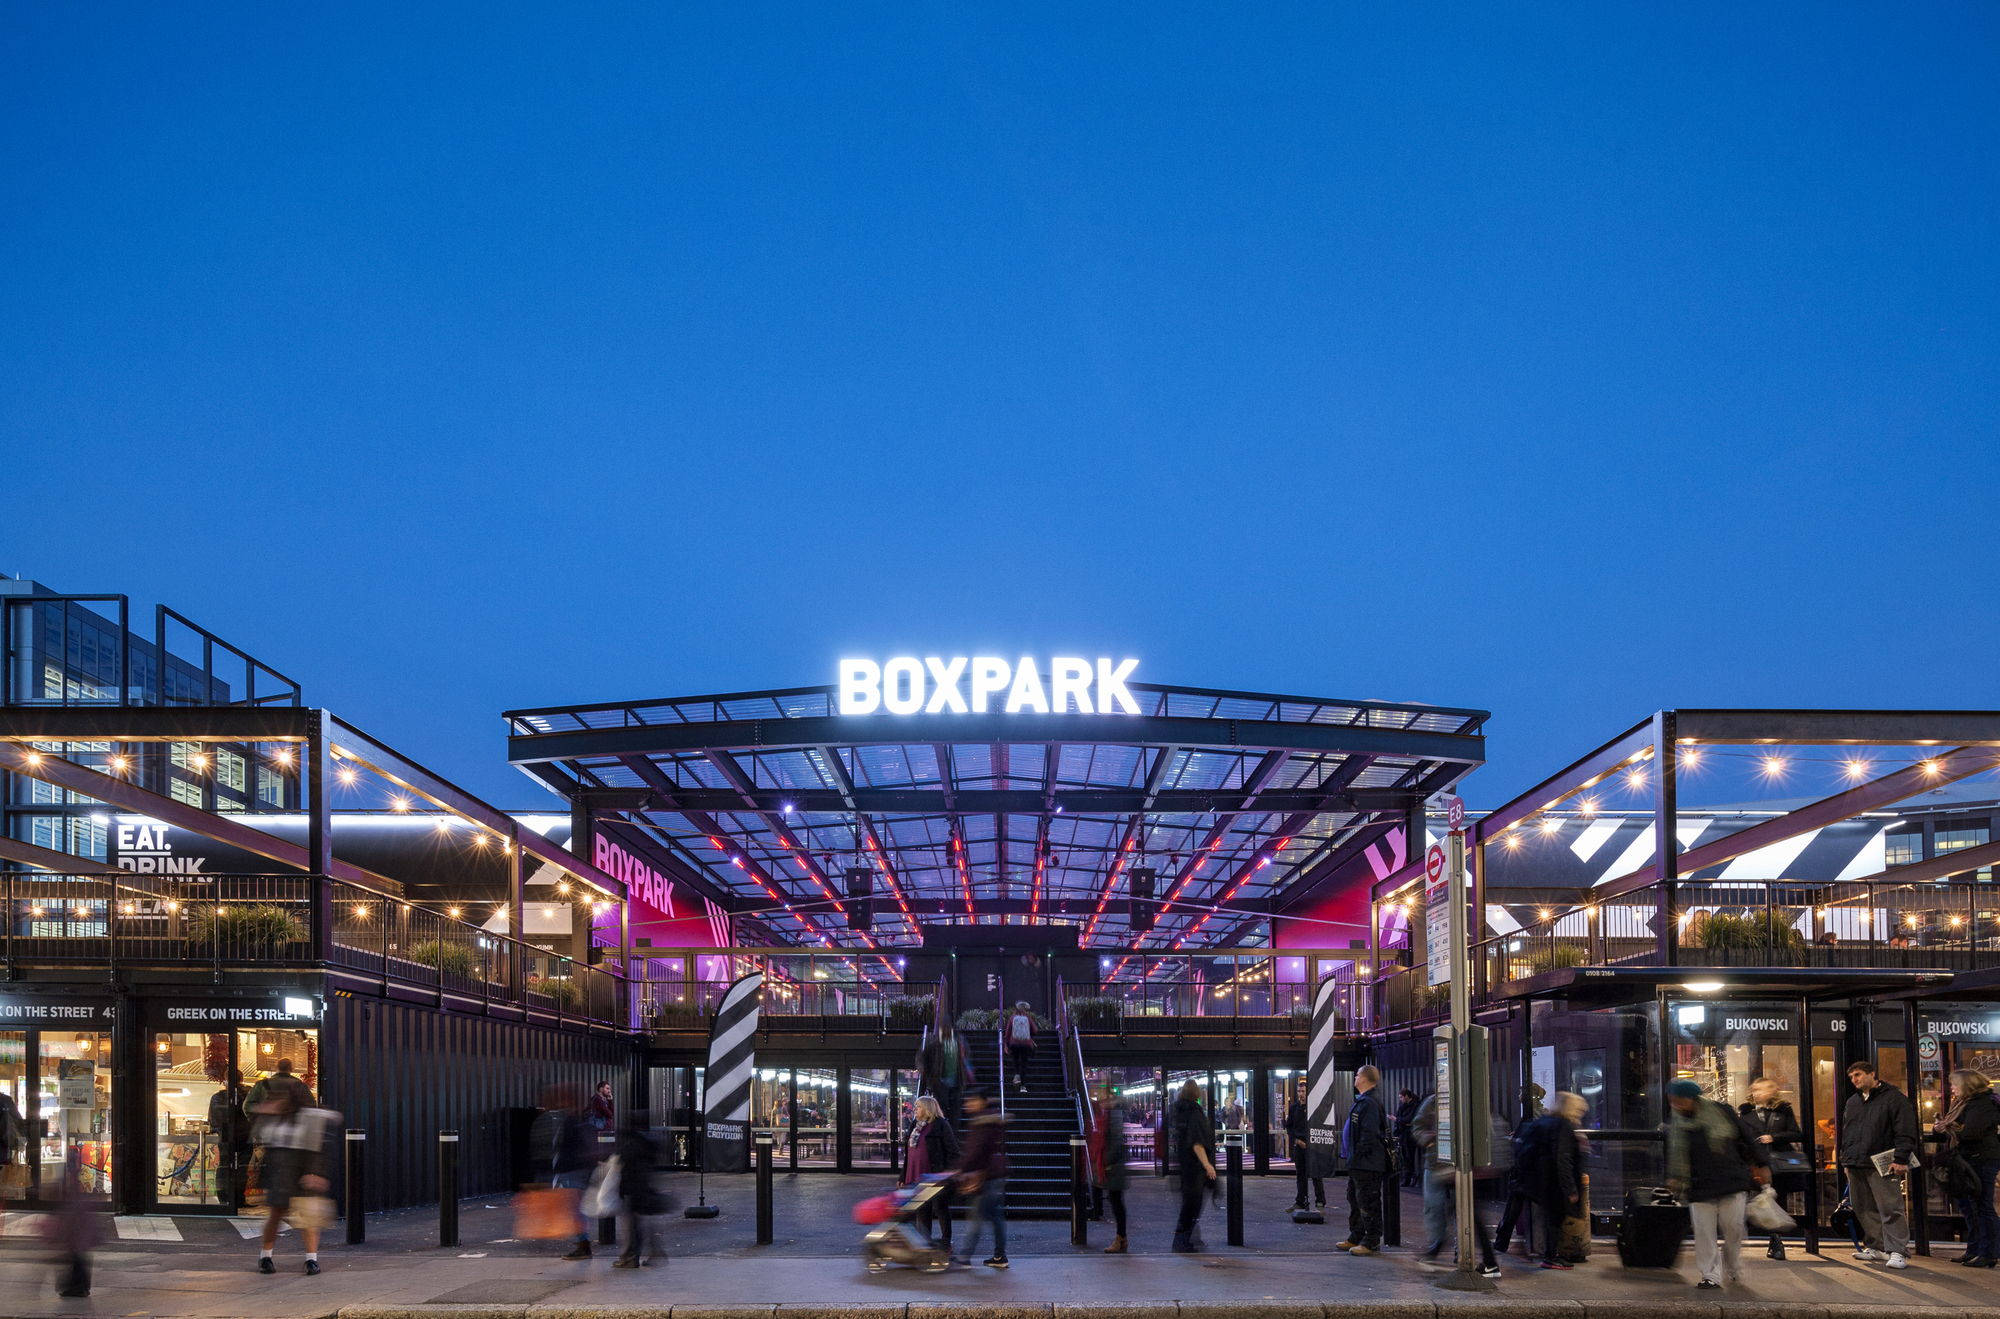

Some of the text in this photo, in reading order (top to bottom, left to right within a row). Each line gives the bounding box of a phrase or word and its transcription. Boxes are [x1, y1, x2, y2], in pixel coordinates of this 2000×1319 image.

[840, 657, 1142, 715] BOXPARK
[1449, 803, 1462, 824] E8
[118, 825, 171, 850] EAT.
[118, 857, 214, 883] DRINK.
[596, 832, 675, 918] BOXPARK
[5, 1006, 22, 1017] ON
[24, 1006, 48, 1018] THE
[50, 1007, 95, 1018] STREET
[167, 1008, 208, 1020] GREEK
[209, 1008, 228, 1020] ON
[229, 1008, 253, 1020] THE
[1725, 1018, 1847, 1032] BUKOWSKI 06
[1927, 1021, 1990, 1035] BUKOWSKI
[707, 1122, 743, 1132] BOXPARK
[1310, 1128, 1334, 1137] BOXPARK
